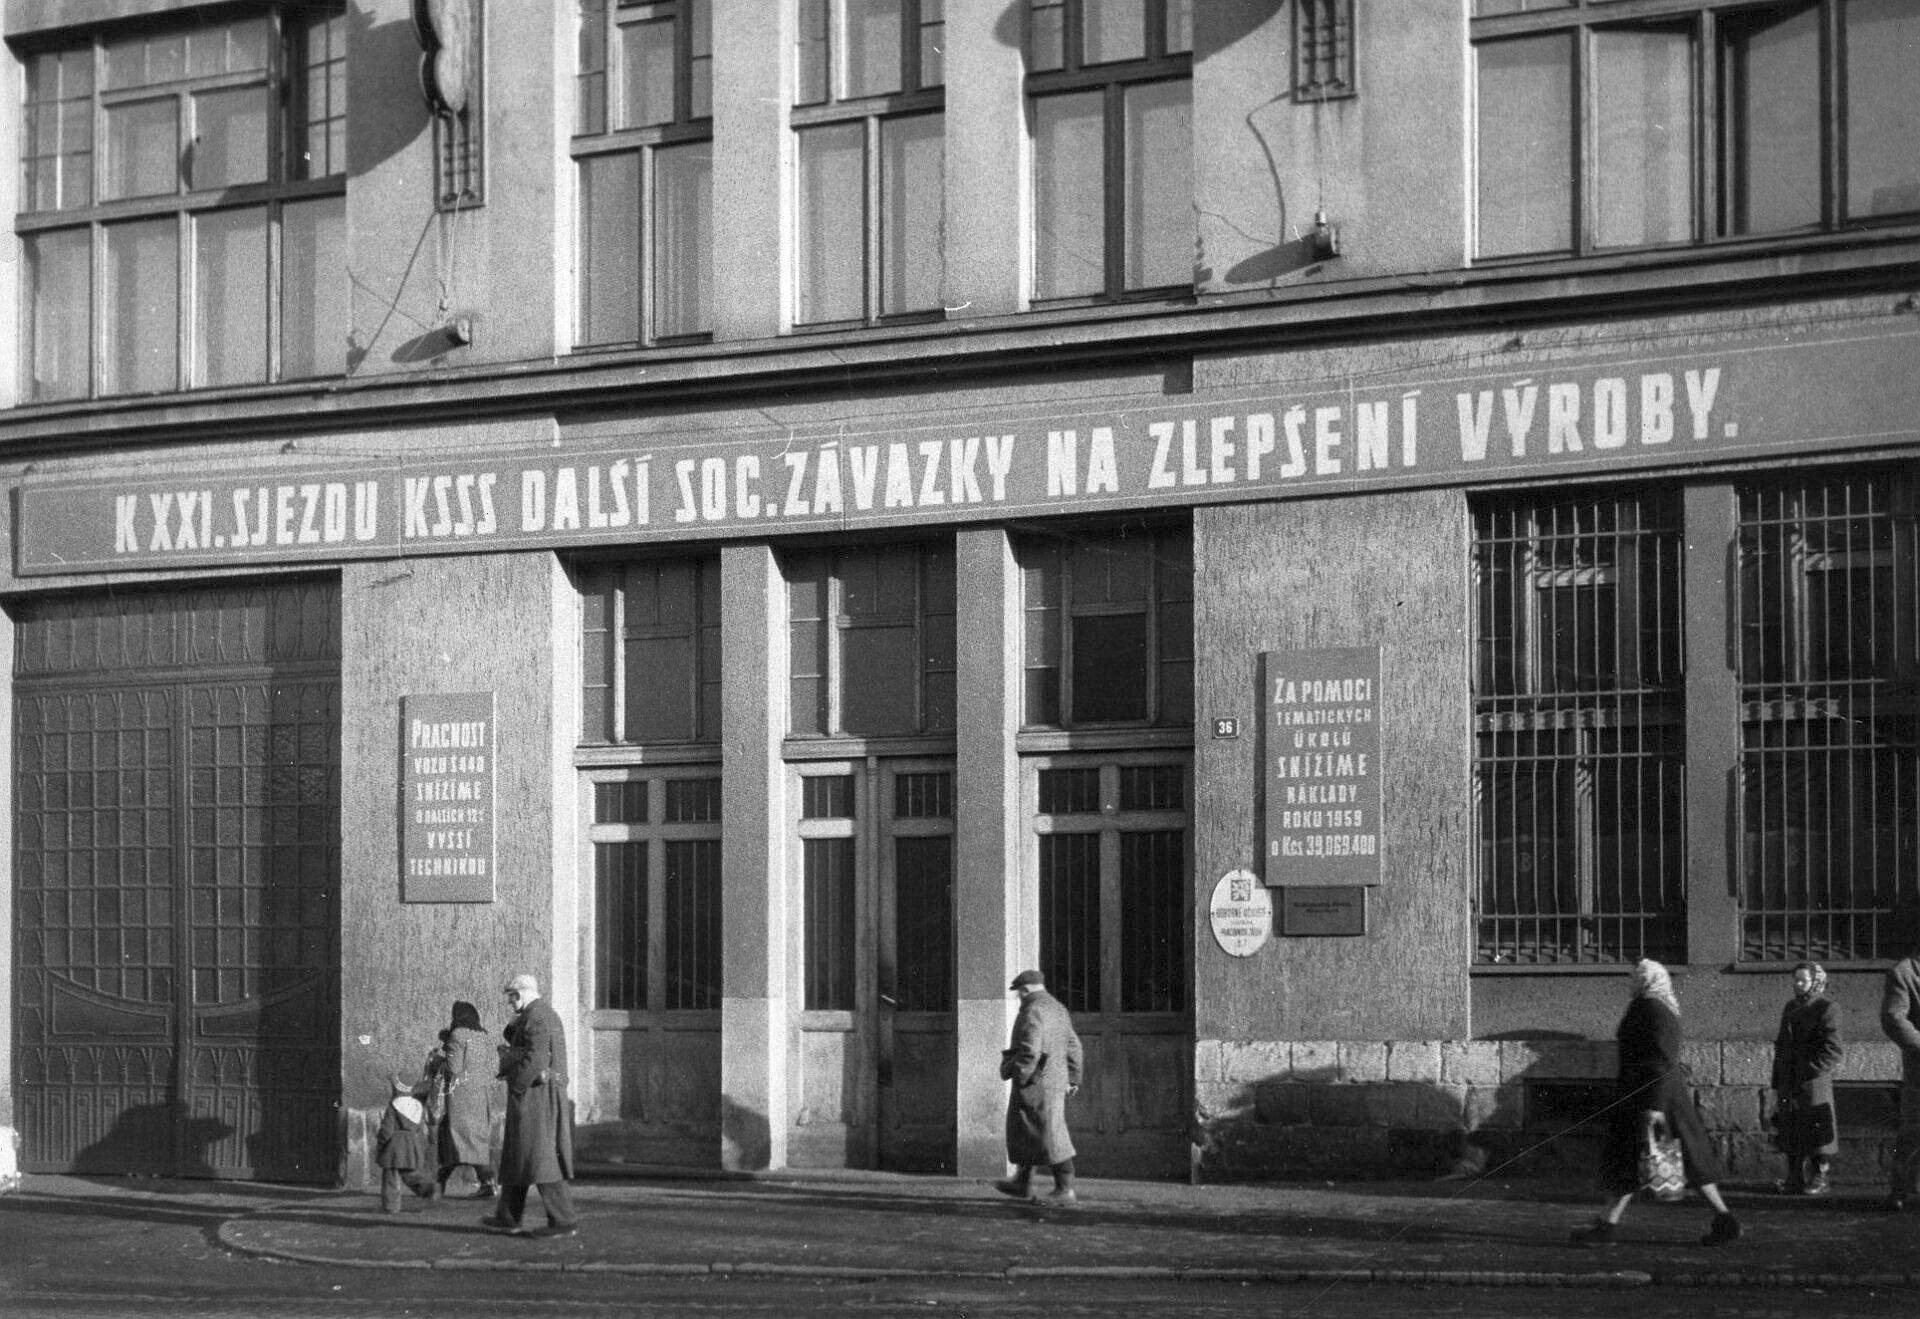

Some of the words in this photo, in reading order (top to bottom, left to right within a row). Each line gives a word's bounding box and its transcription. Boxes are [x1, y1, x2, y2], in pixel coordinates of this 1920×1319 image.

[115, 495, 138, 553] K
[404, 473, 497, 538] KSSS
[521, 454, 653, 532] DALŠÍ
[1047, 426, 1119, 496] NA
[1147, 390, 1421, 489] ZLEPŠENÍ
[1456, 367, 1738, 461] VÝROBY.
[1301, 677, 1372, 703] POMOCI
[412, 718, 486, 748] PRACNOST
[1218, 721, 1233, 735] 36
[1276, 751, 1368, 779] SNÍŽÍME
[1287, 782, 1357, 804] NÁKLADY
[1283, 810, 1322, 829] ROKU
[1326, 809, 1362, 828] 1959
